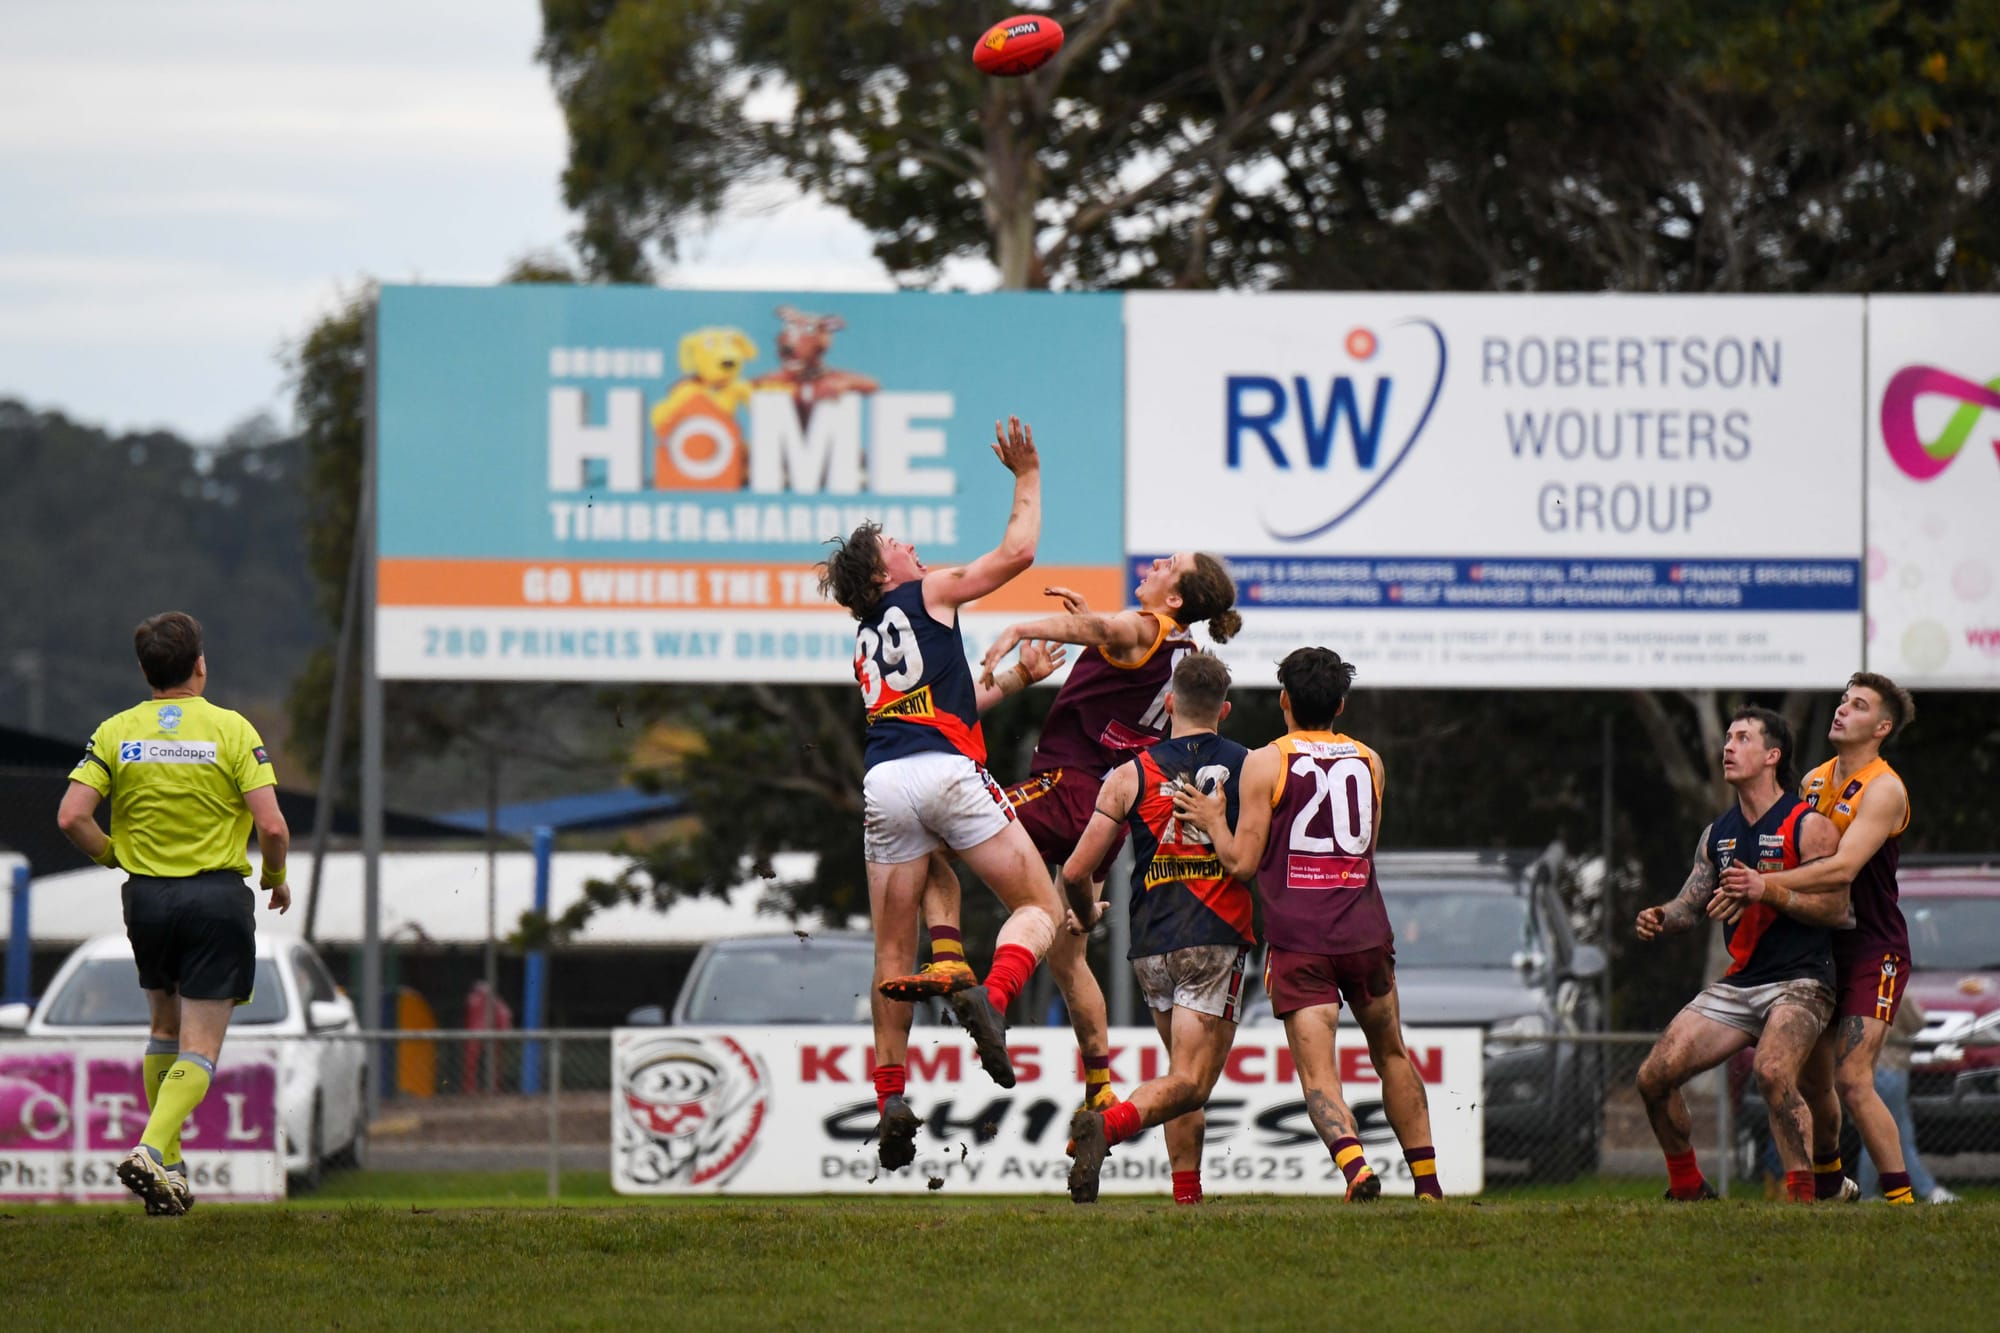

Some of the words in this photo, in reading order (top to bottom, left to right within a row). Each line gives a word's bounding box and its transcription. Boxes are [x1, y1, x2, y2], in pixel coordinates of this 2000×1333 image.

[1008, 23, 1037, 37] Work
[1481, 338, 1782, 389] ROBERTSON
[549, 386, 956, 496] HOME
[1223, 374, 1393, 470] RW
[1505, 411, 1751, 461] WOUTERS
[1538, 483, 1712, 533] GROUP
[523, 567, 572, 602] GO
[580, 569, 699, 604] WHERE
[708, 571, 770, 605] THE
[423, 627, 488, 658] 280
[500, 628, 640, 659] PRINCES
[653, 632, 721, 659] WAY
[149, 746, 215, 759] Candappa
[1289, 755, 1373, 855] 20
[1075, 1046, 1443, 1084] KICEN
[1000, 1155, 1174, 1180] Avaable
[1207, 1156, 1304, 1181] 5625
[1319, 1156, 1415, 1181] 226
